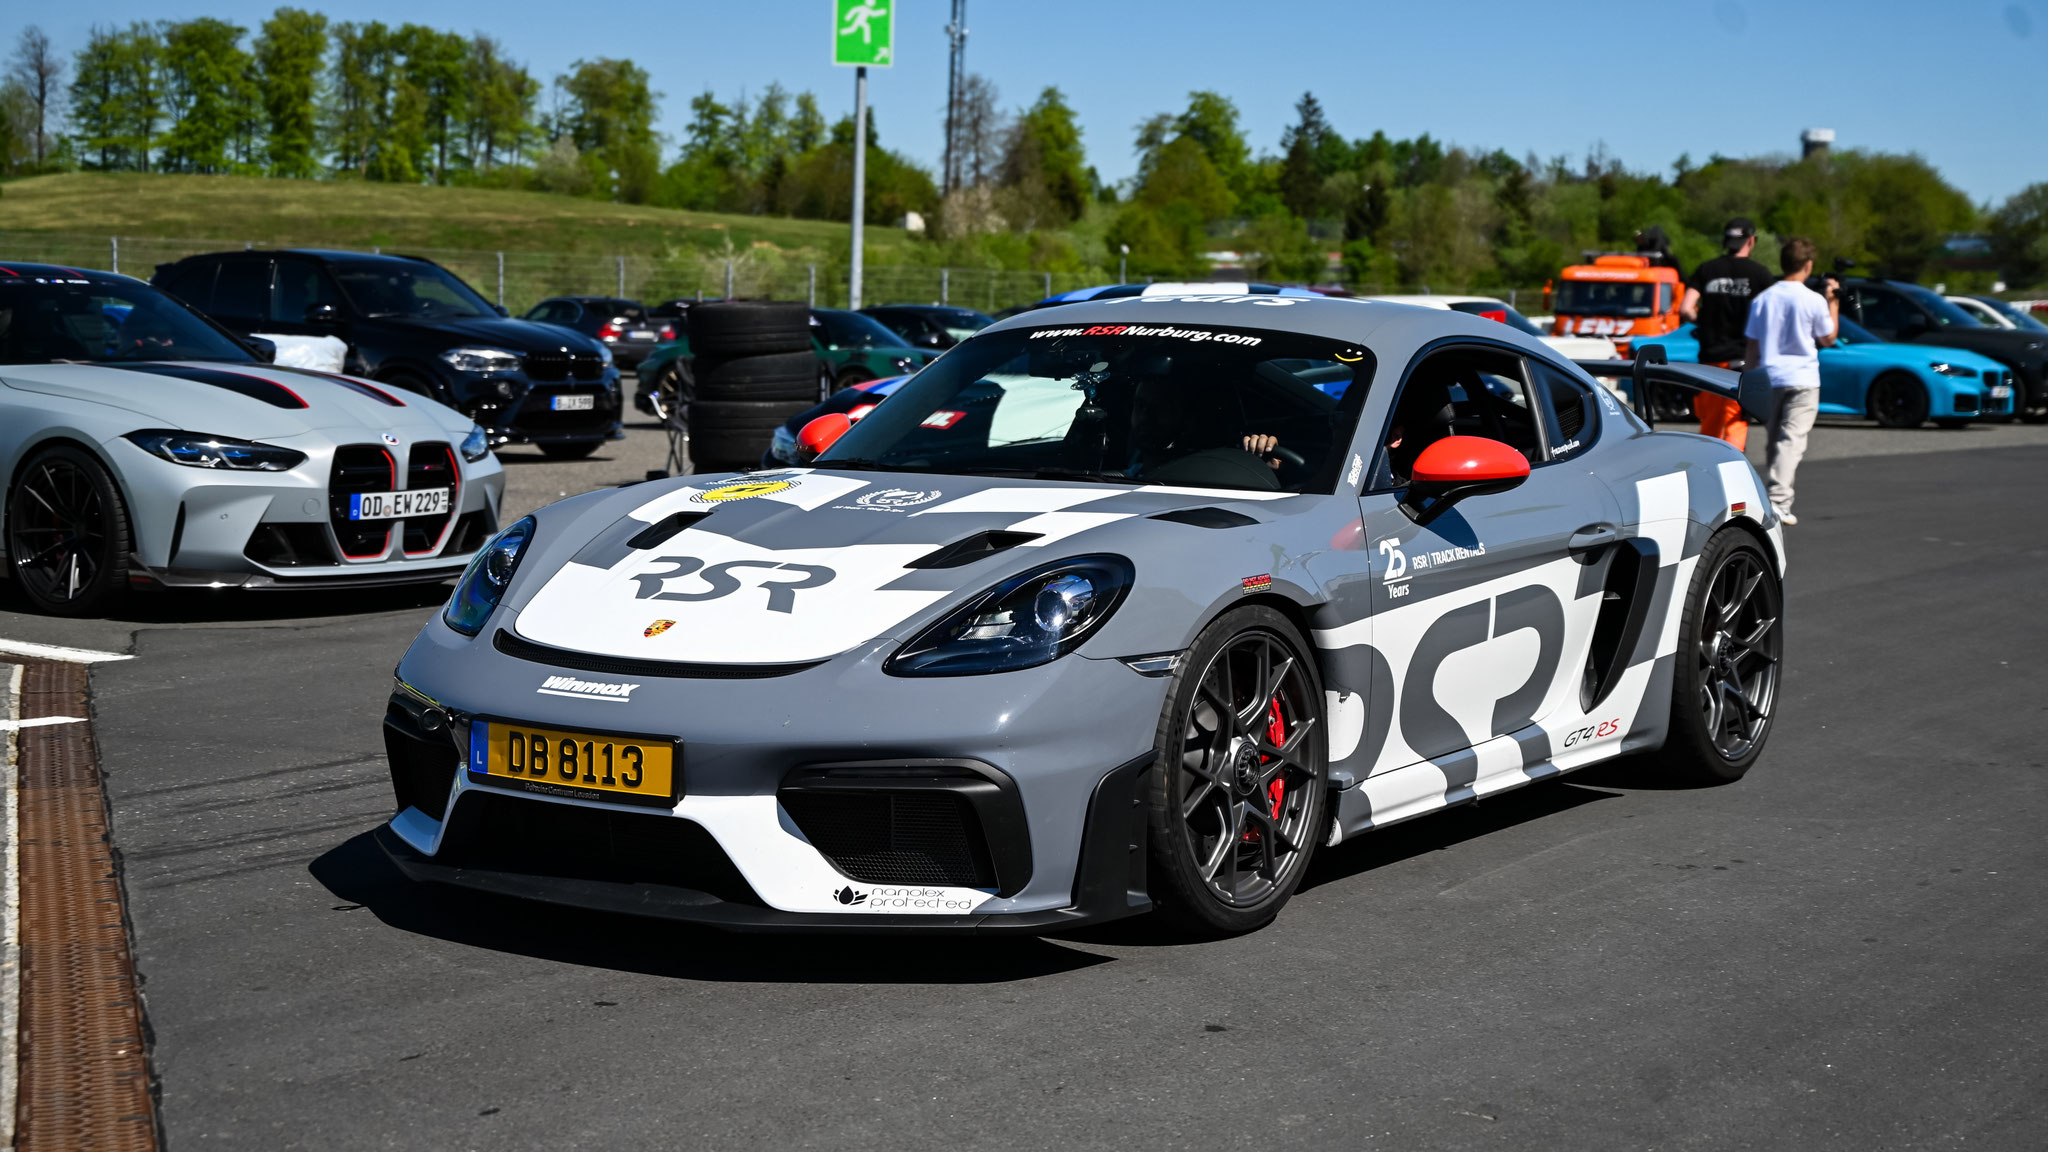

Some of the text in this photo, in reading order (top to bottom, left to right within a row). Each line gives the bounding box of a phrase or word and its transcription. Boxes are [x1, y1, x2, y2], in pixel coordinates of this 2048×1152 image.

[1030, 325, 1262, 347] www.RSRNurburg.com
[362, 496, 382, 517] OD
[394, 494, 412, 515] EW
[415, 492, 440, 514] 229
[1379, 537, 1407, 581] 25
[1412, 542, 1486, 570] RSR TRACK RENTALS
[629, 555, 837, 614] RSR
[1387, 584, 1410, 599] Years
[1564, 718, 1620, 748] GT4 RS
[476, 750, 483, 765] L
[509, 731, 644, 787] DB 8113
[870, 896, 972, 910] protected
[871, 887, 946, 897] nanolex
